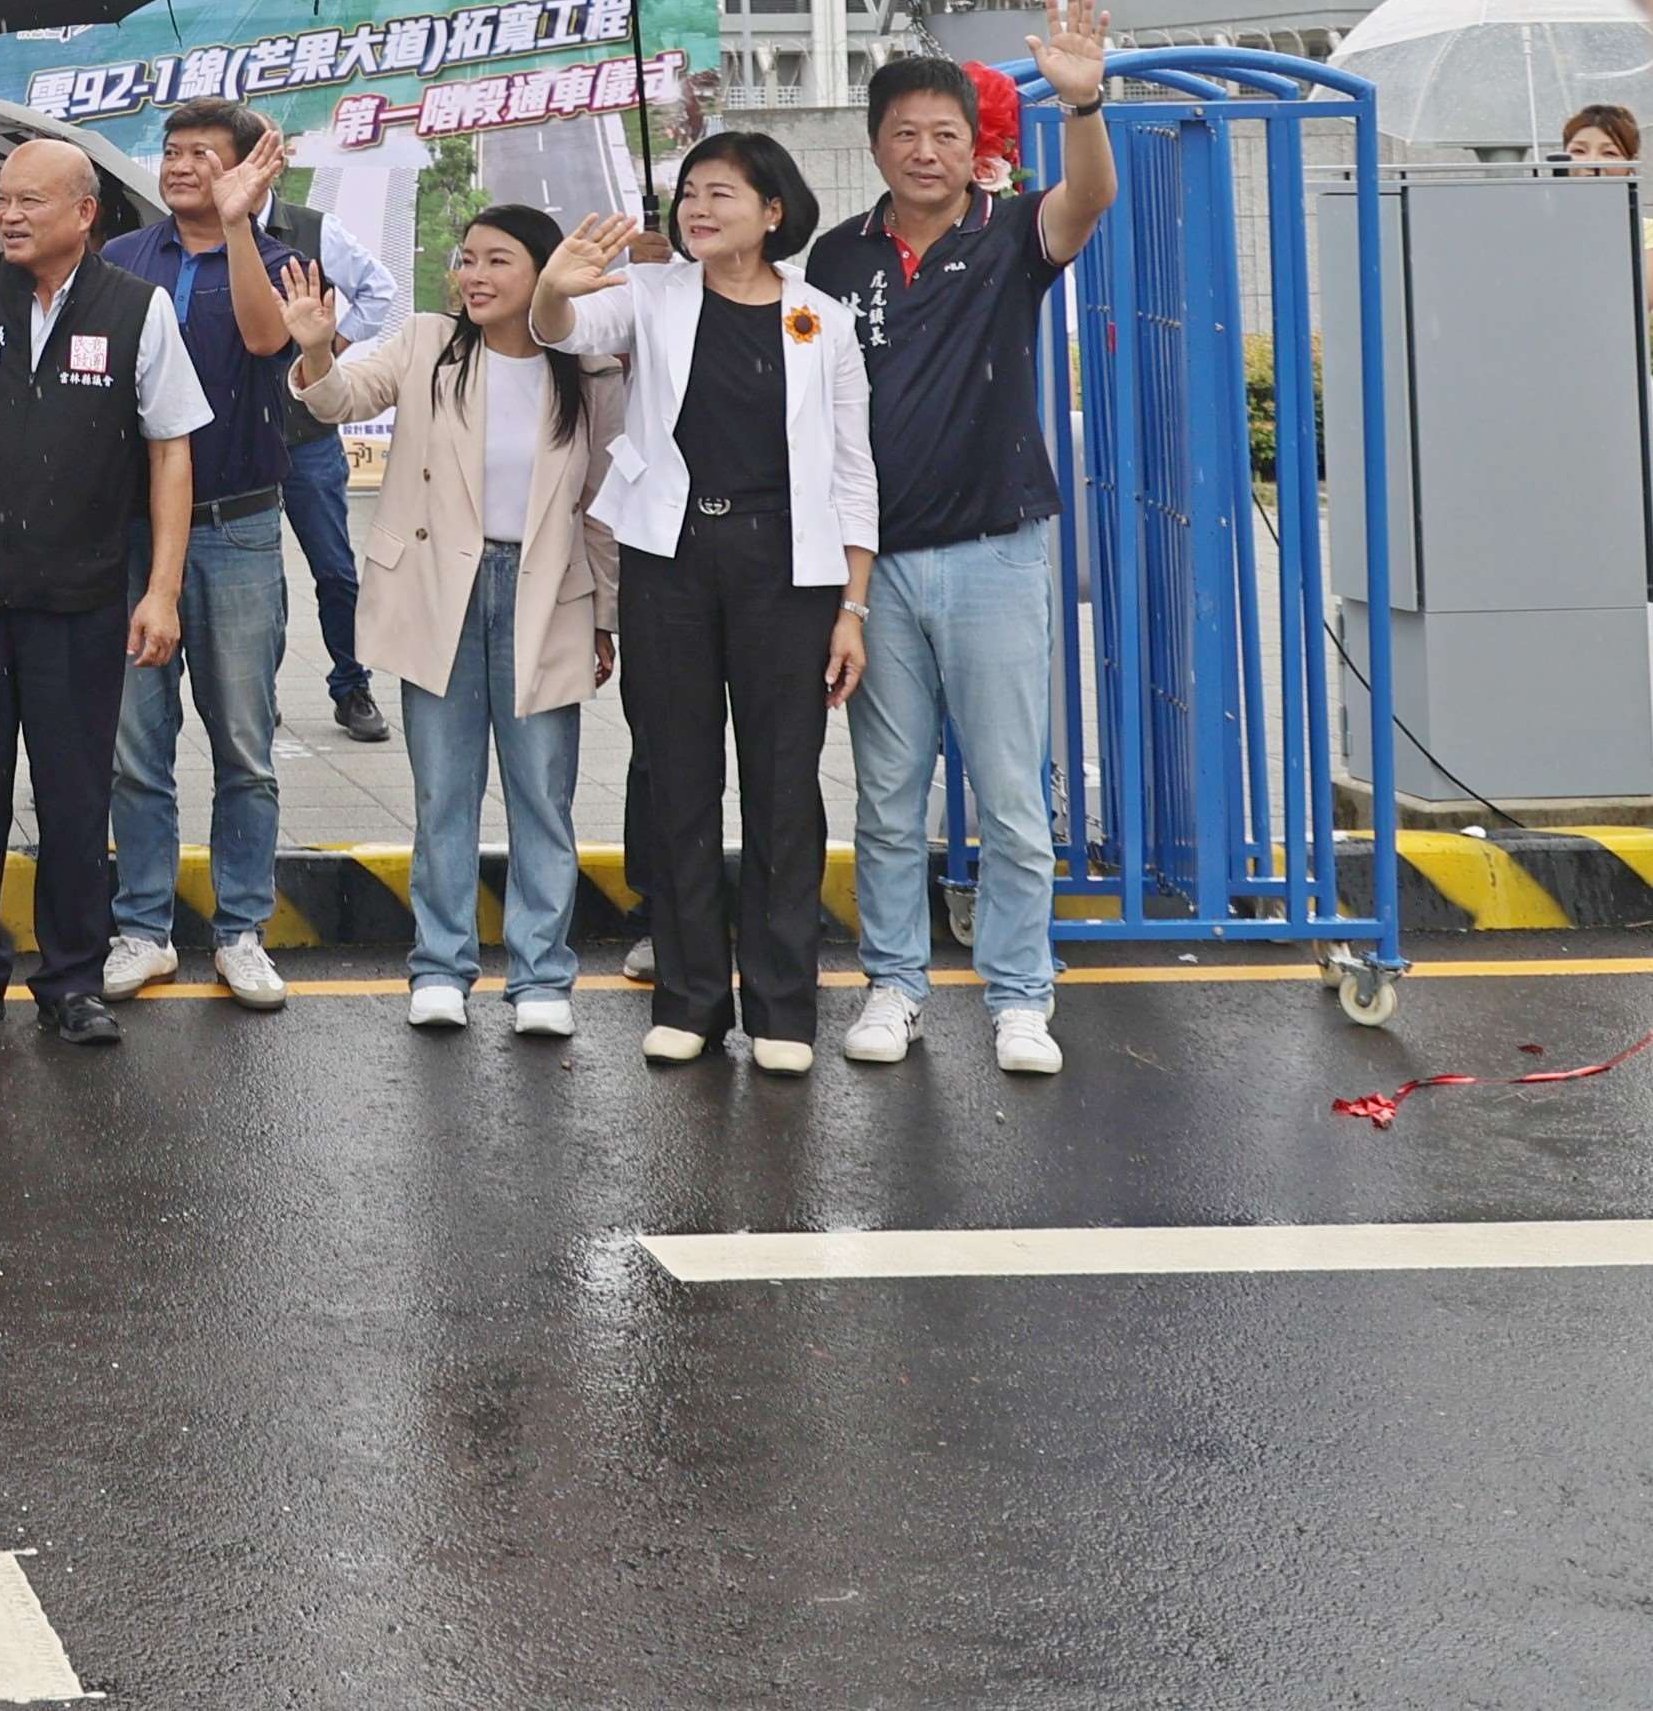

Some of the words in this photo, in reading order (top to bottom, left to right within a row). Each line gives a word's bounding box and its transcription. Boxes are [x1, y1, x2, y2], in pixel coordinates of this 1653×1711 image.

[336, 51, 685, 147] 第一階段通車儀式
[869, 270, 888, 347] 虎尾鎮長
